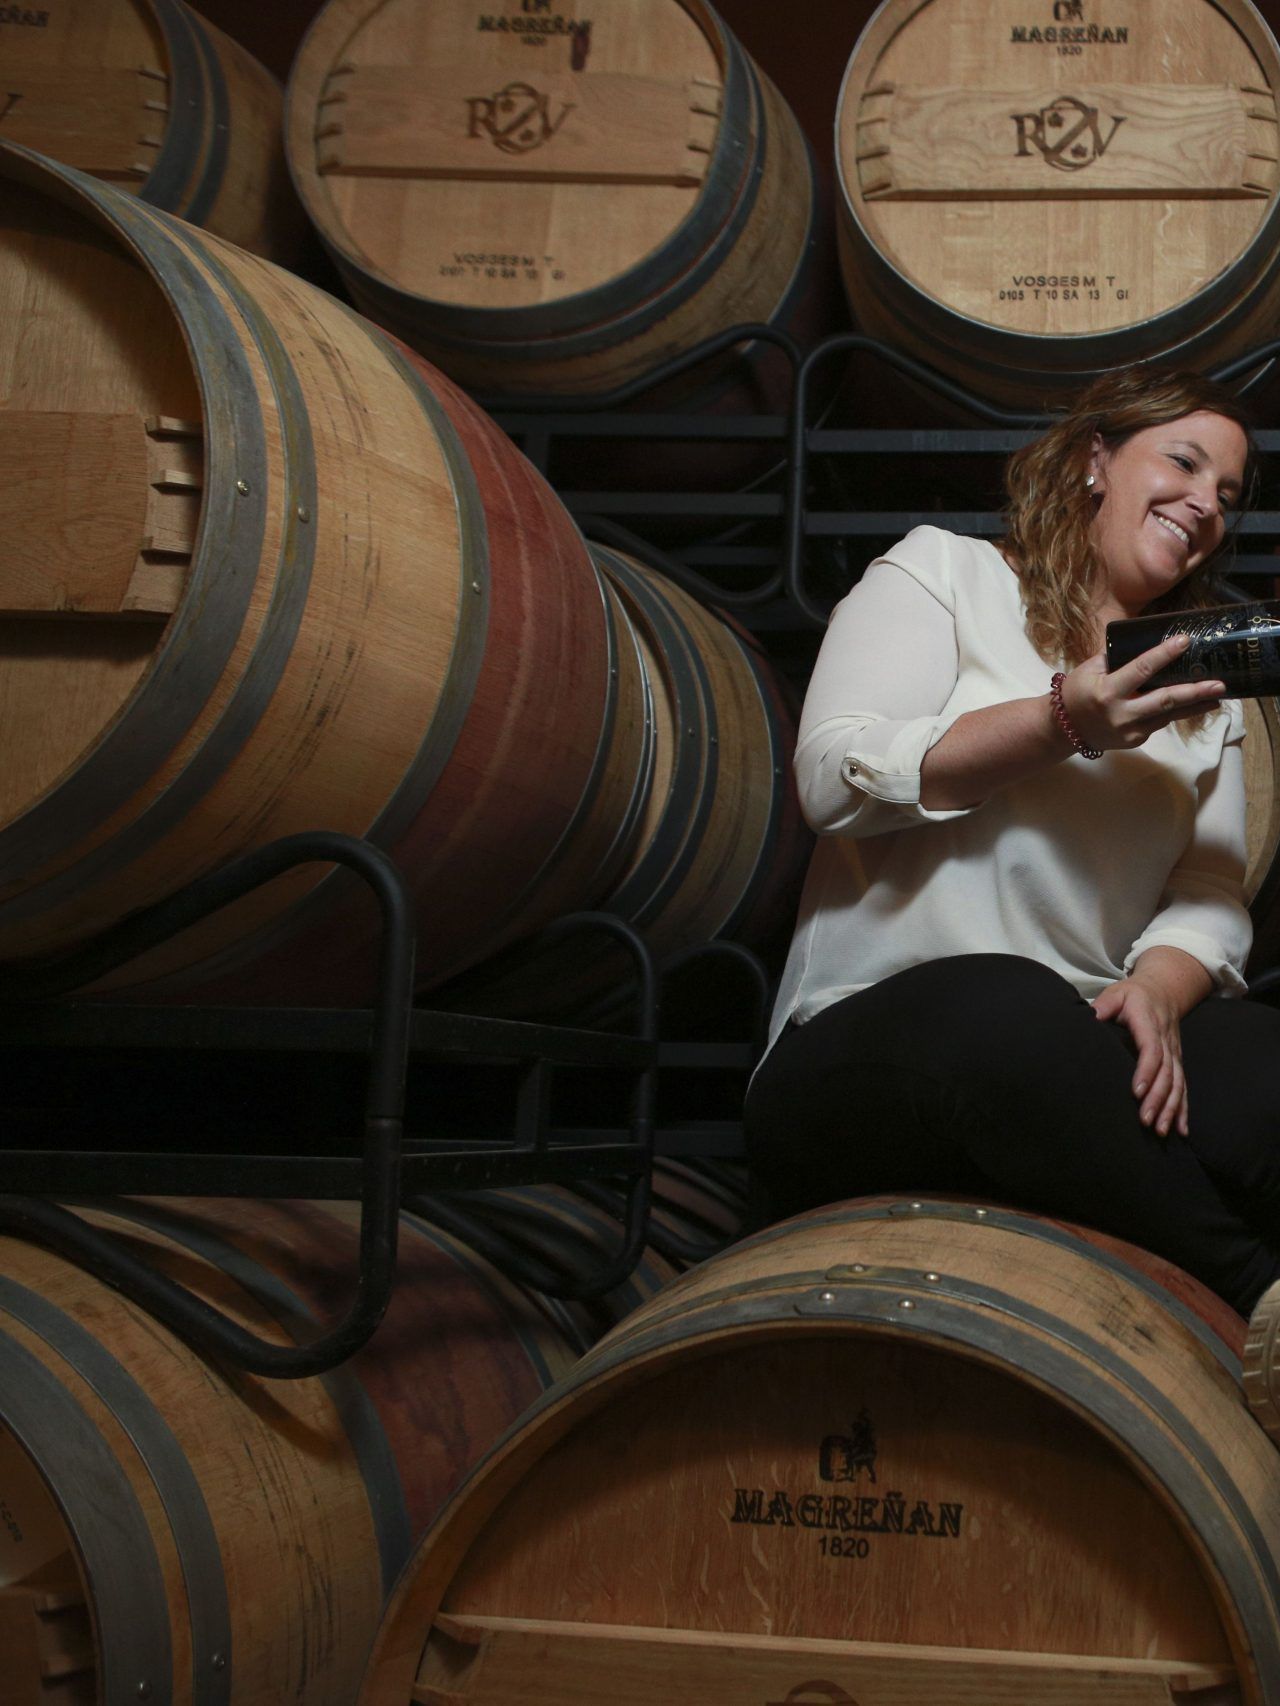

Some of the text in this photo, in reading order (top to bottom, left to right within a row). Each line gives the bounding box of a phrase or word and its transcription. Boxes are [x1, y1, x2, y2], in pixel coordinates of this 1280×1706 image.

[1010, 23, 1128, 43] MAGREÑAN
[1046, 289, 1058, 300] 10
[1062, 289, 1079, 300] SA
[1088, 289, 1100, 300] 13
[730, 1488, 964, 1538] MAGREÑAN
[818, 1535, 870, 1558] 1820
